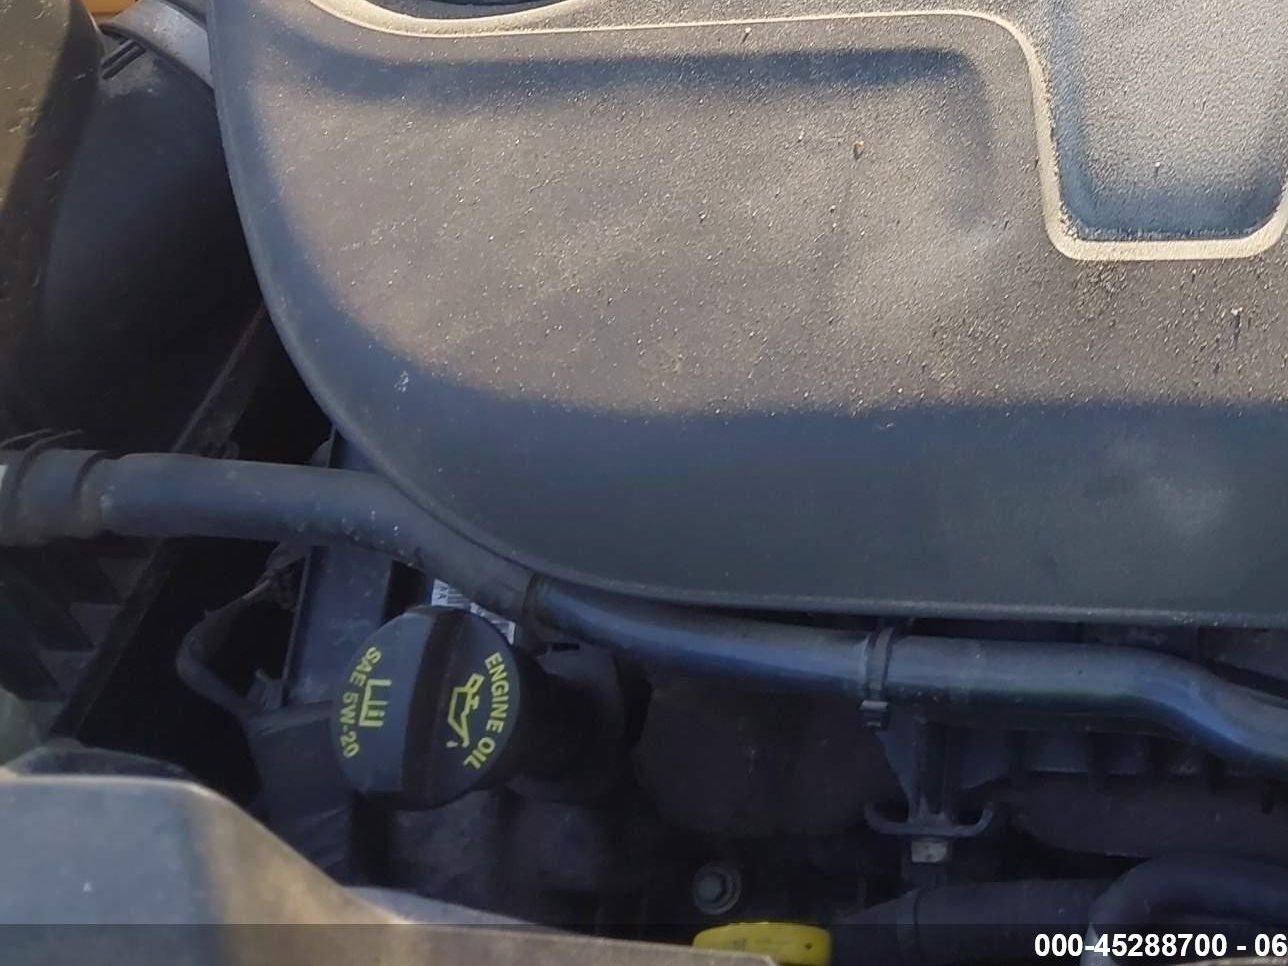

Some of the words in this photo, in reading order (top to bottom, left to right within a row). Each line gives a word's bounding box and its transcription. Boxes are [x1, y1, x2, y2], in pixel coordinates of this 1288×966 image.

[350, 647, 382, 687] SAE
[484, 652, 510, 733] ENGINE
[339, 692, 361, 759] 5W-20
[463, 737, 496, 770] OIL
